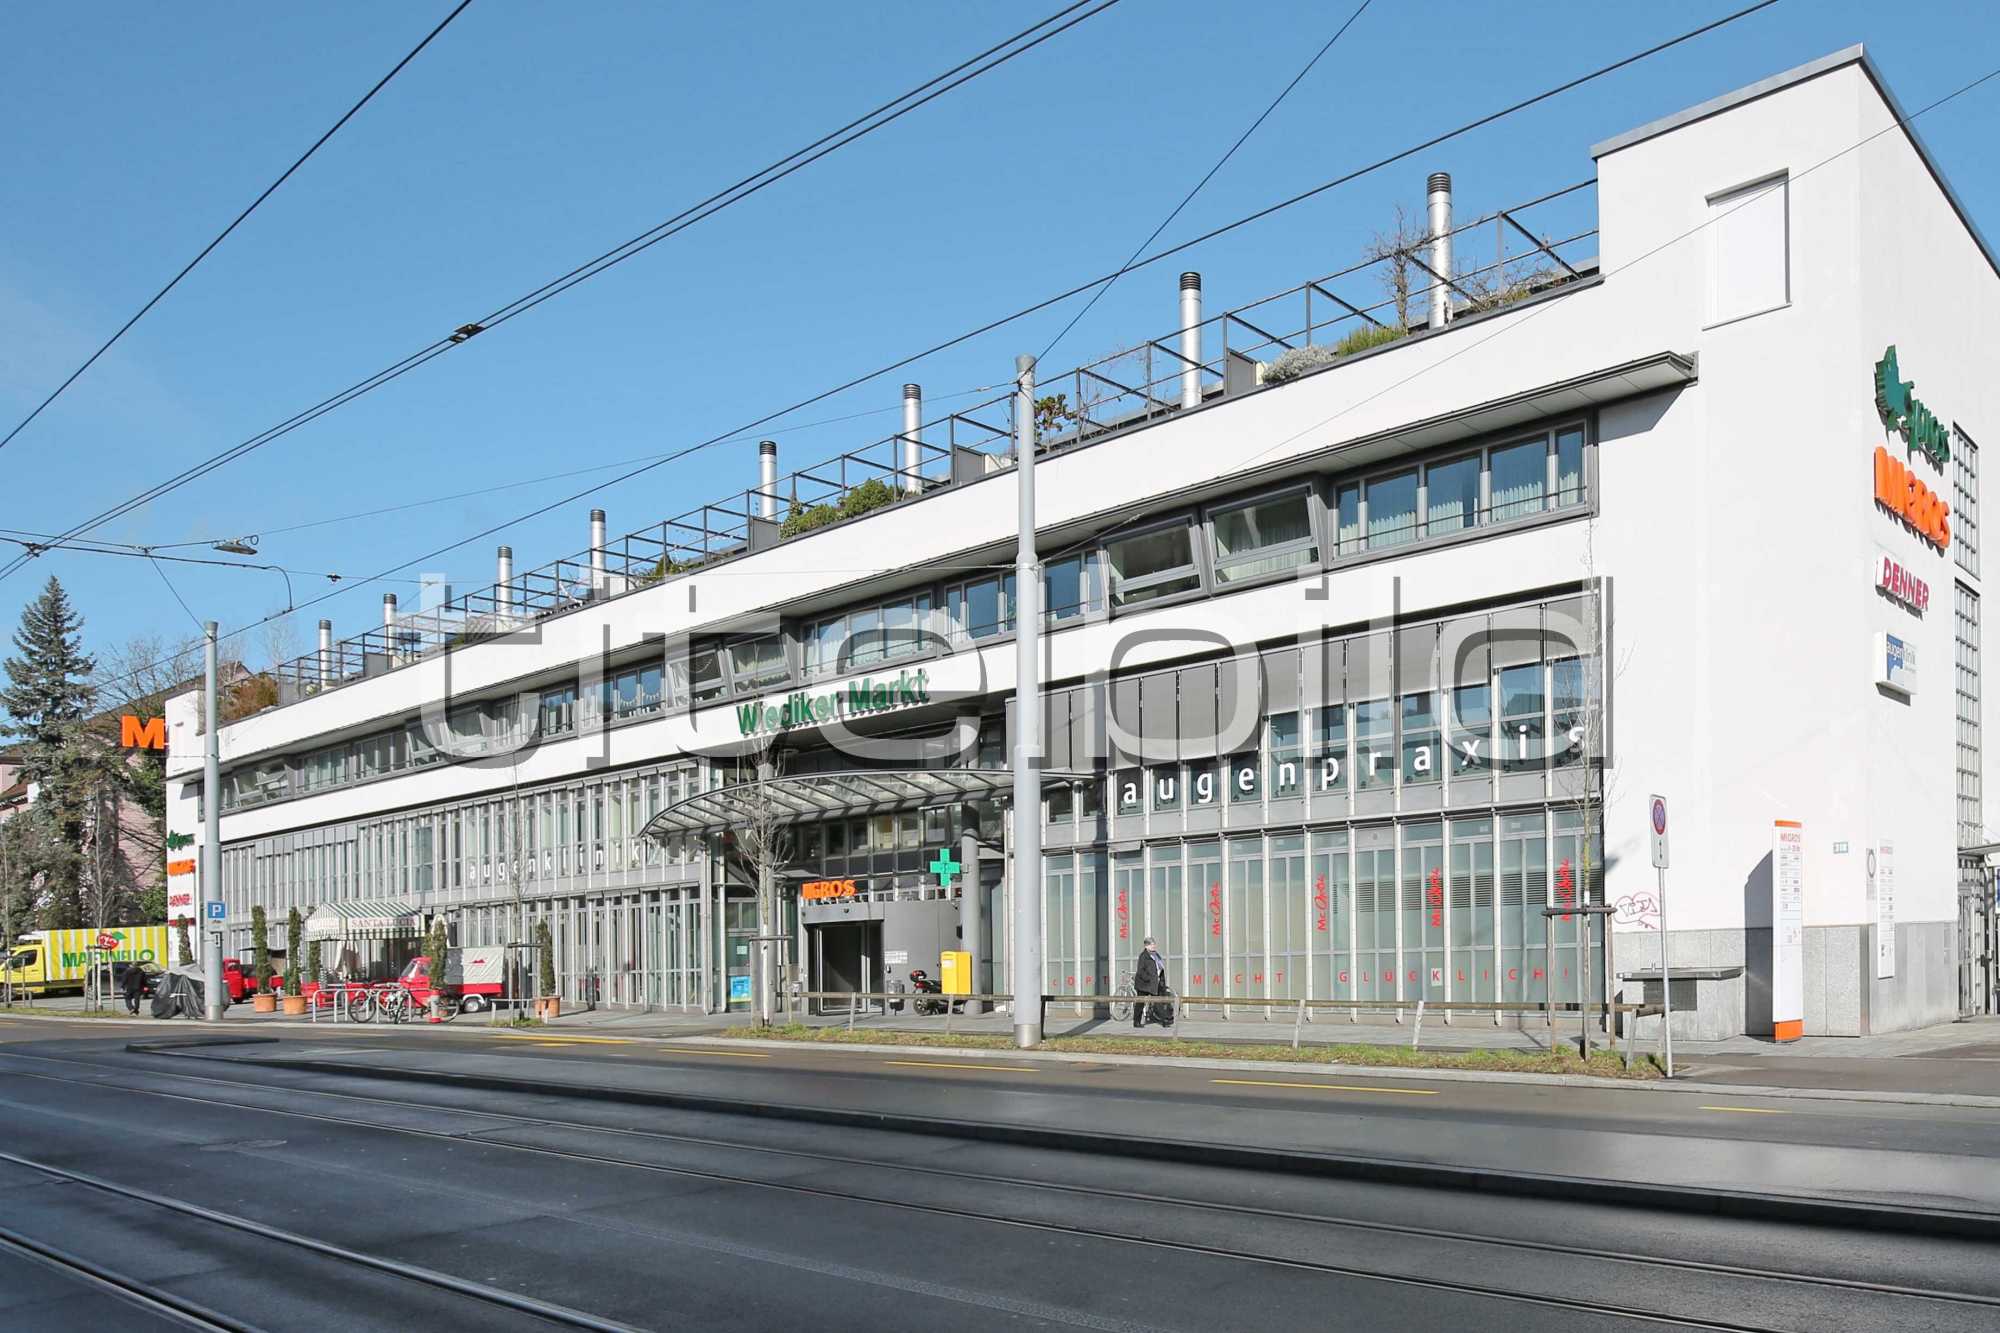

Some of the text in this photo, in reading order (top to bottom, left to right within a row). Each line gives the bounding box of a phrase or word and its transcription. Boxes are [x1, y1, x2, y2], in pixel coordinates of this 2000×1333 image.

[1882, 556, 1930, 610] DENNER
[736, 668, 930, 735] Wiediker Markt
[122, 715, 165, 750] M
[1123, 725, 1587, 804] augenpraxis
[212, 904, 222, 917] P
[802, 880, 857, 899] GROS
